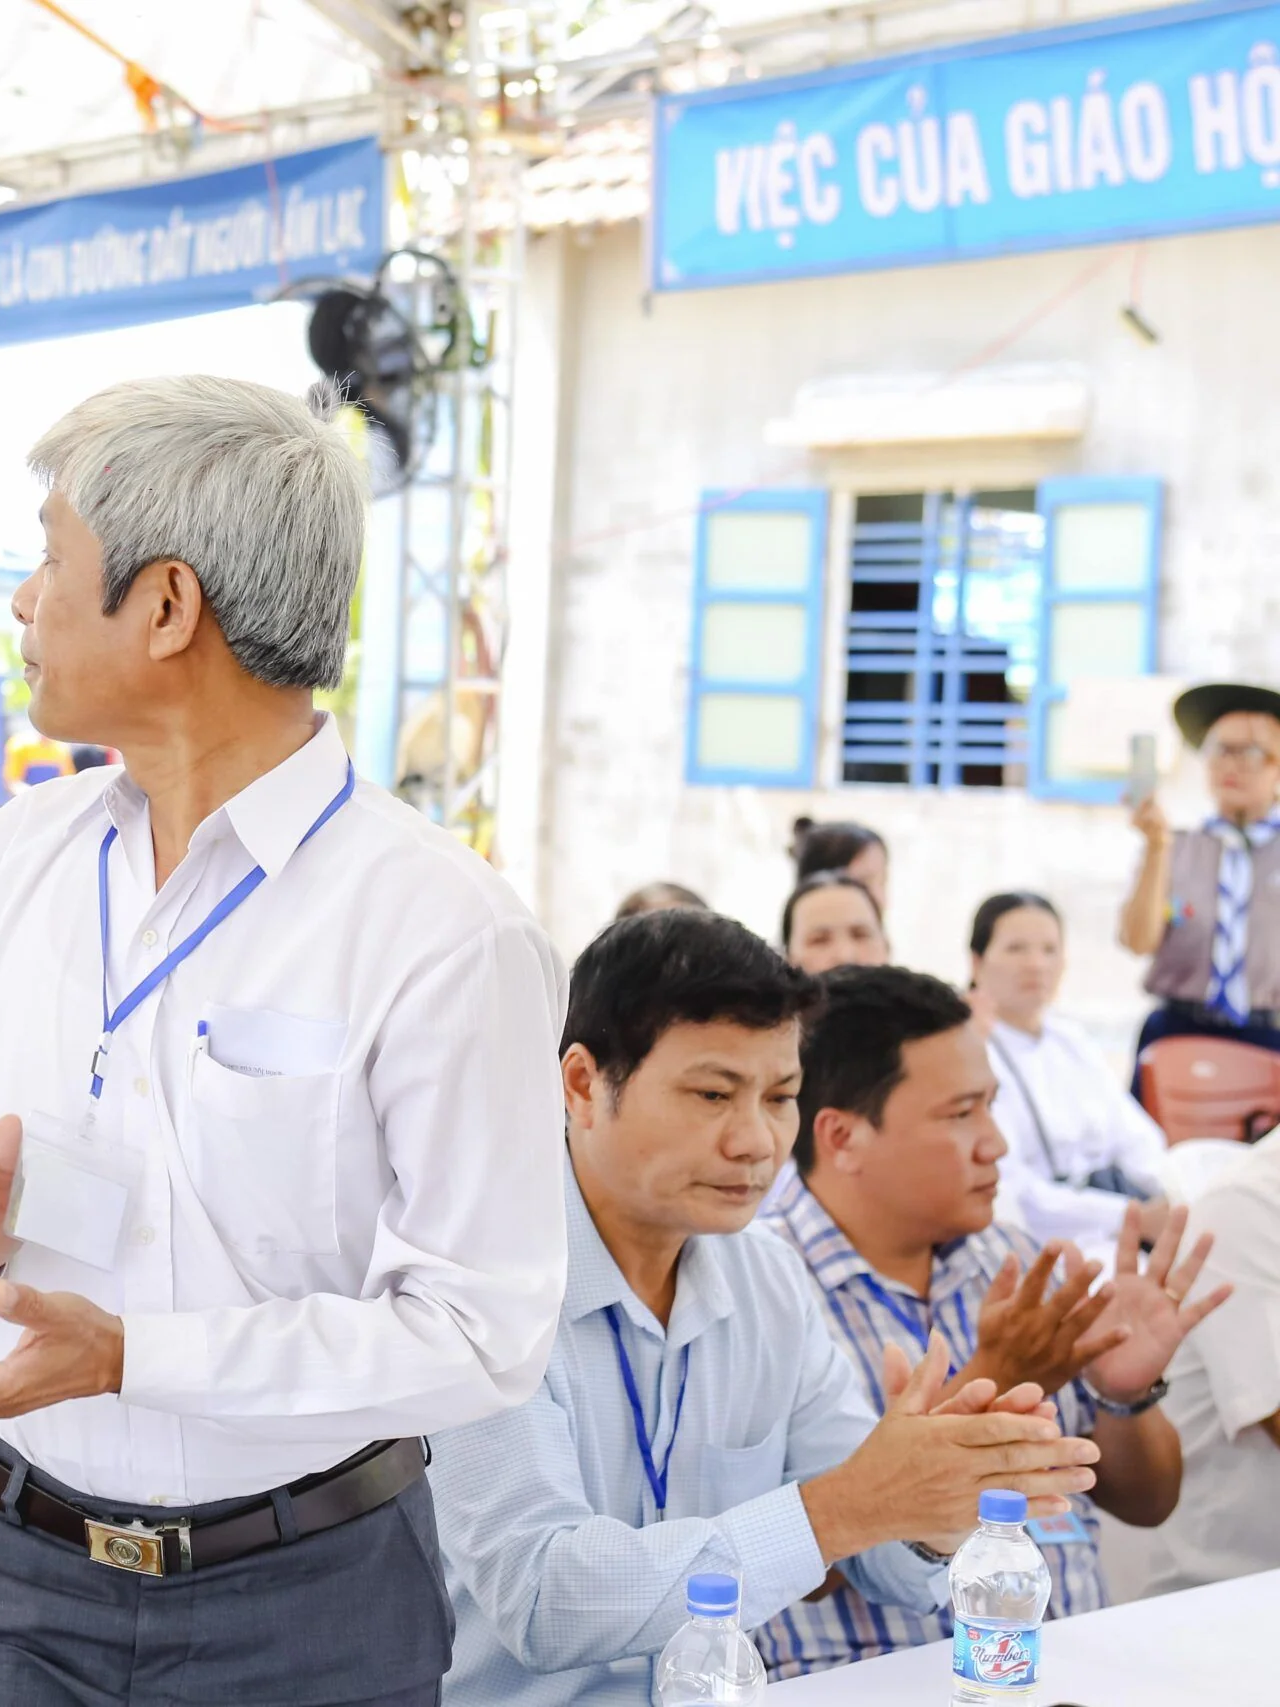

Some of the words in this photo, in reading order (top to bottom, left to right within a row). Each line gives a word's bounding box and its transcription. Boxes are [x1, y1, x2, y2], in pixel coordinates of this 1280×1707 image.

[715, 121, 841, 250] VIỆC
[856, 85, 990, 218] CỦA
[1005, 69, 1172, 199] GIÁO
[972, 1645, 1029, 1664] Number
